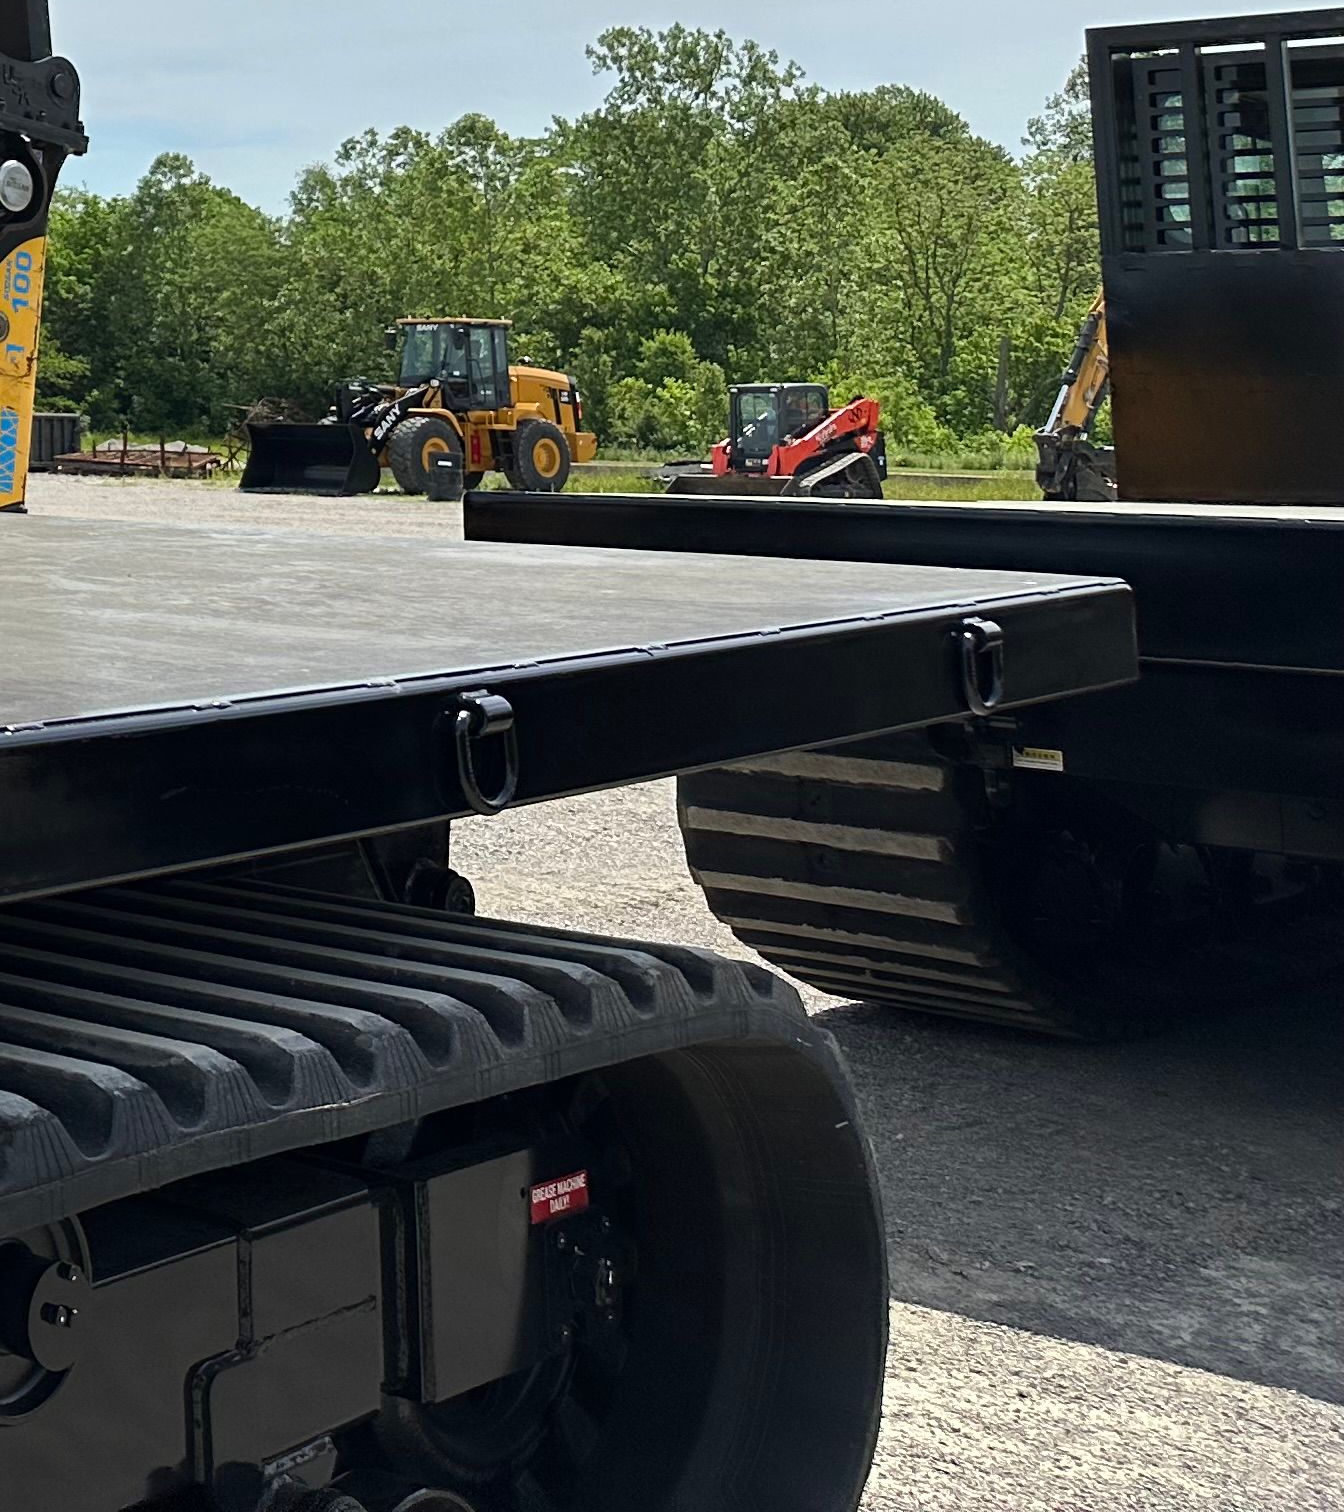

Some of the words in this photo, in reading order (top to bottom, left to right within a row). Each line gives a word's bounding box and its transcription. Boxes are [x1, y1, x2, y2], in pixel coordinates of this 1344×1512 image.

[12, 250, 32, 313] 100
[374, 403, 401, 441] SANY
[532, 1182, 557, 1204] GREASE
[557, 1173, 586, 1195] MACHINE
